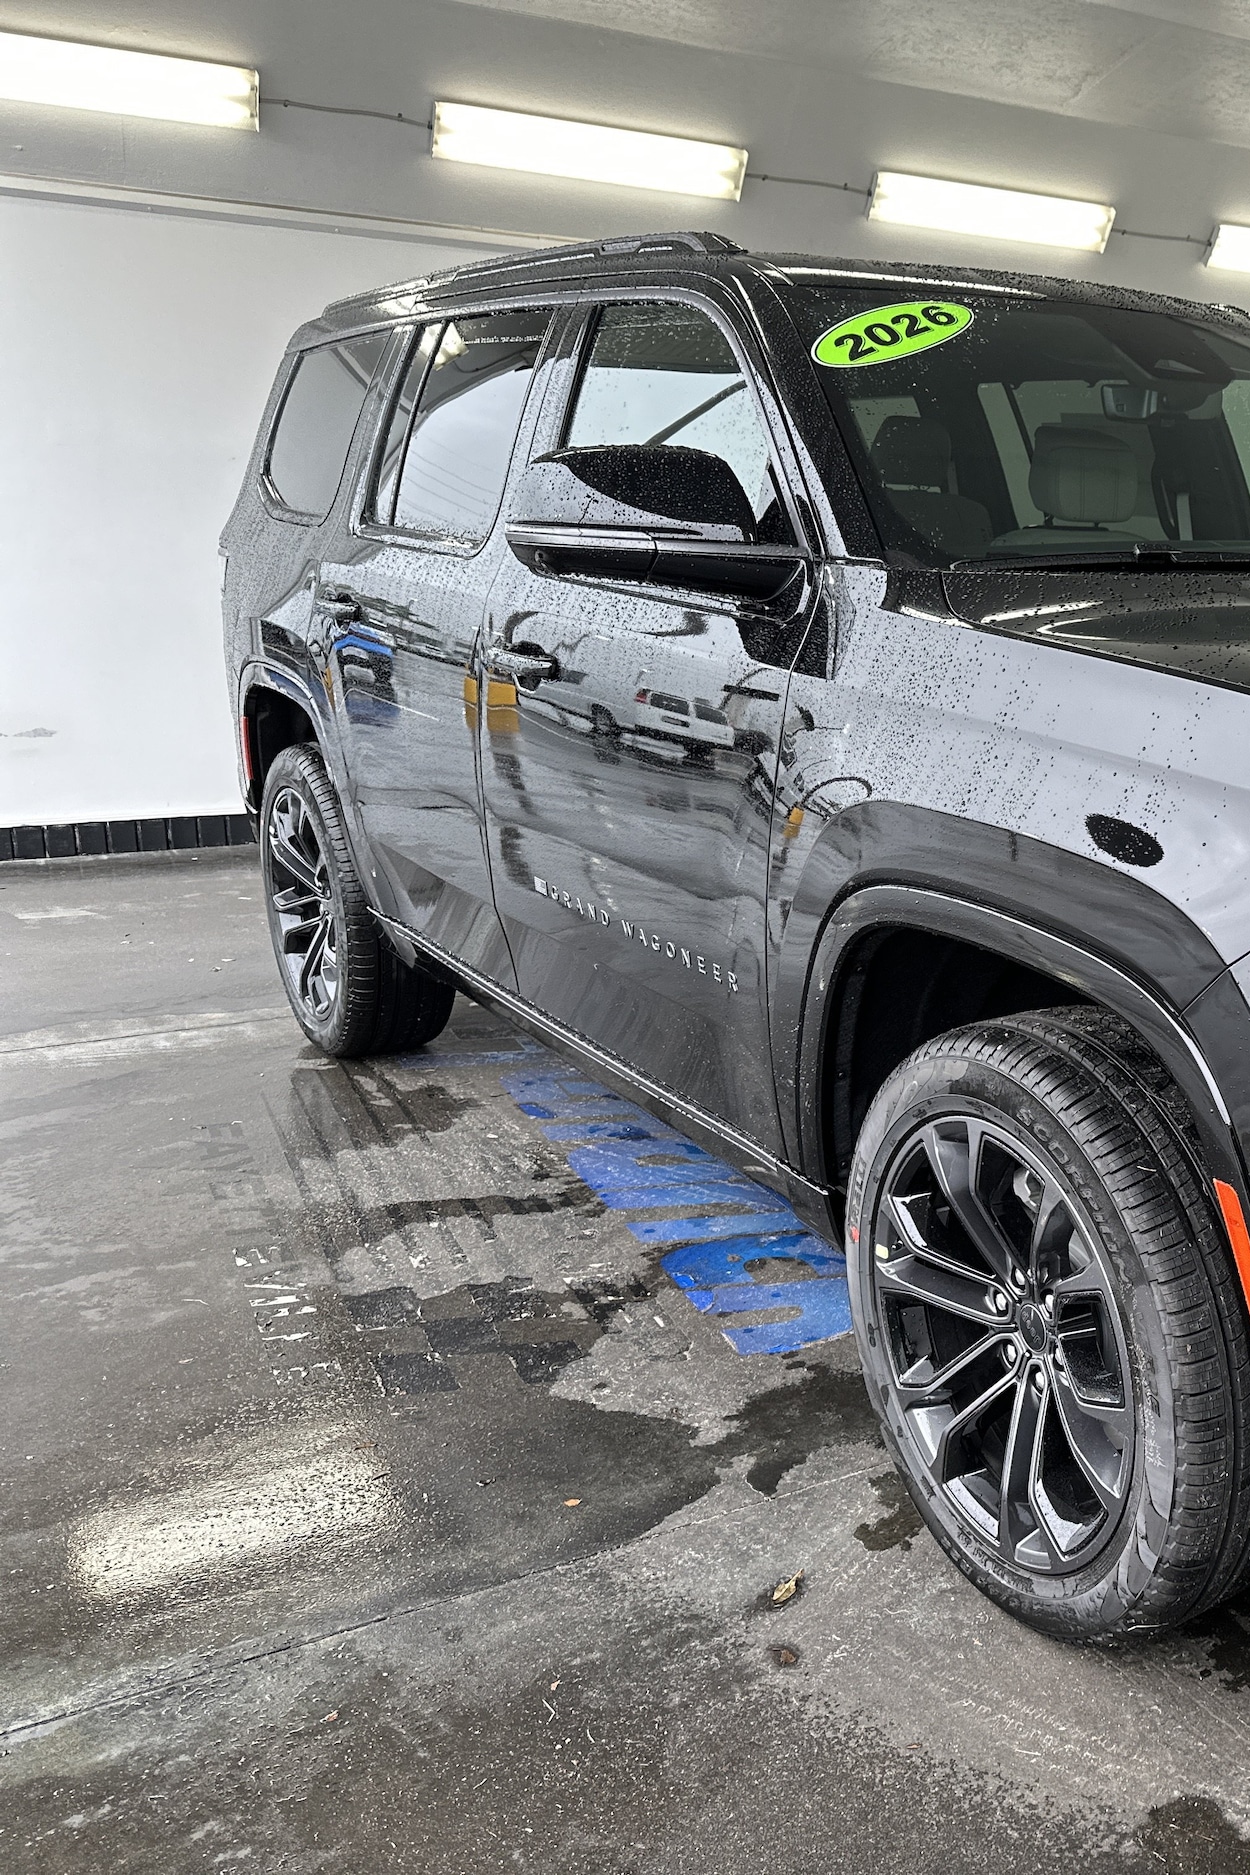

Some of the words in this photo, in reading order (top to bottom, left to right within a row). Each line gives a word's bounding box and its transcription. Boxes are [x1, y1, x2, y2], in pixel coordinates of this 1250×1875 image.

[834, 305, 958, 362] 2026
[550, 885, 610, 927] GRAND
[620, 918, 739, 992] WAGONEER
[1016, 1107, 1129, 1283] SCORPION
